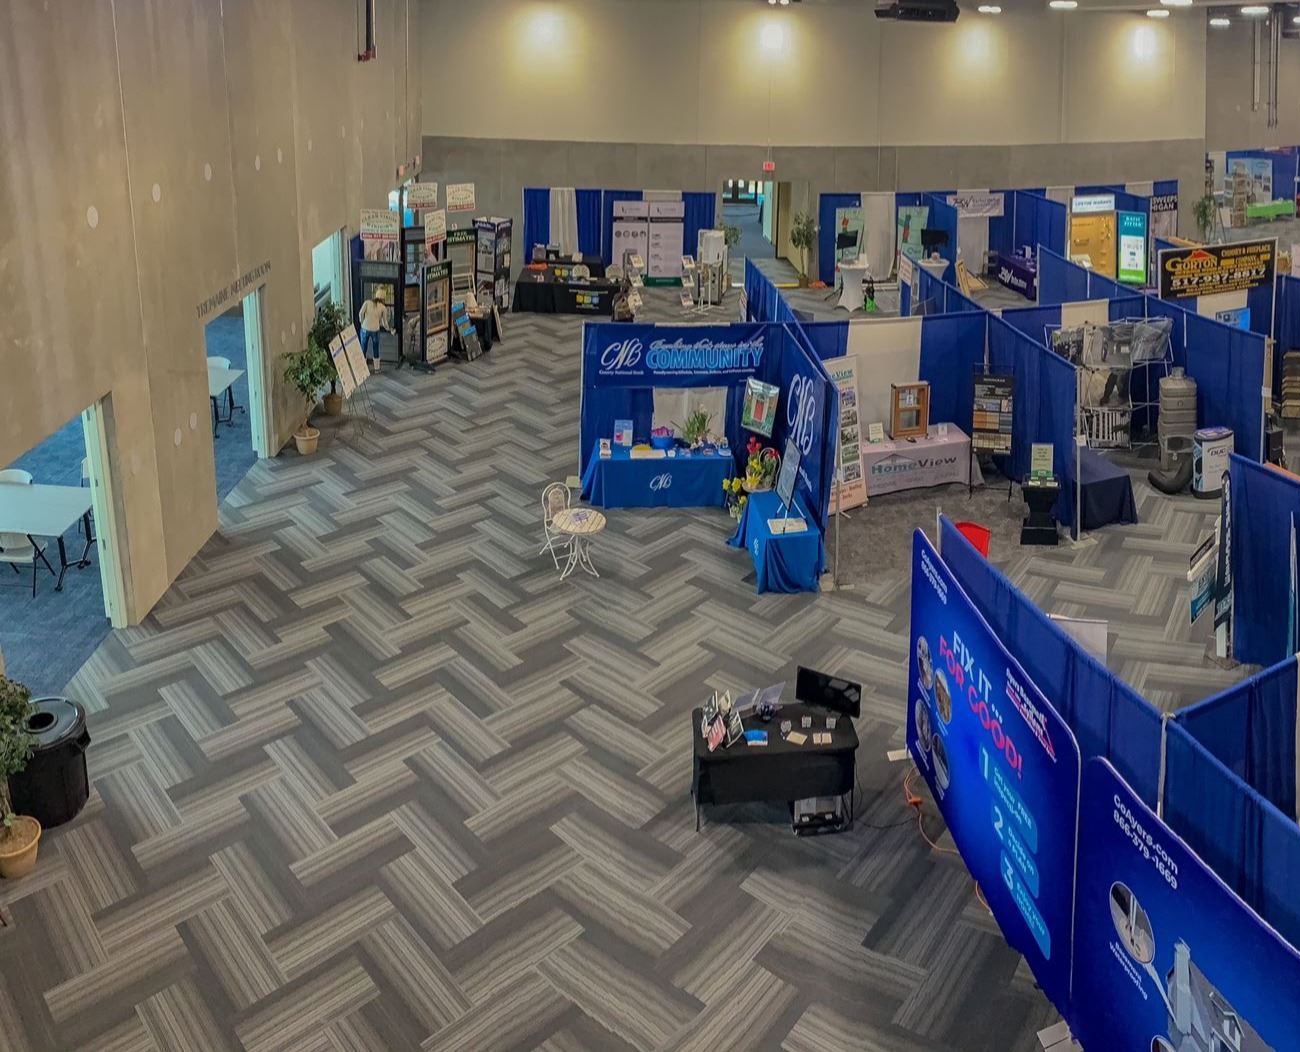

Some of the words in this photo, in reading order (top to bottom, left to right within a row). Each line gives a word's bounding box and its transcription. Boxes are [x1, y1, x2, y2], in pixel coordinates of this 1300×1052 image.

[1165, 257, 1218, 273] GORTON
[646, 347, 764, 370] COMMUNITY
[871, 456, 957, 475] HomeView
[953, 630, 975, 683] FIX
[978, 668, 993, 704] IT
[940, 634, 964, 692] FOR
[967, 684, 1023, 780] GOOD!
[994, 804, 1005, 842] 2
[1113, 794, 1179, 876] GoAyers.com
[1113, 809, 1178, 890] 866-379-1669
[1004, 854, 1015, 892] 3
[1109, 941, 1148, 1001] Waterproofing
[1115, 941, 1142, 983] Basement
